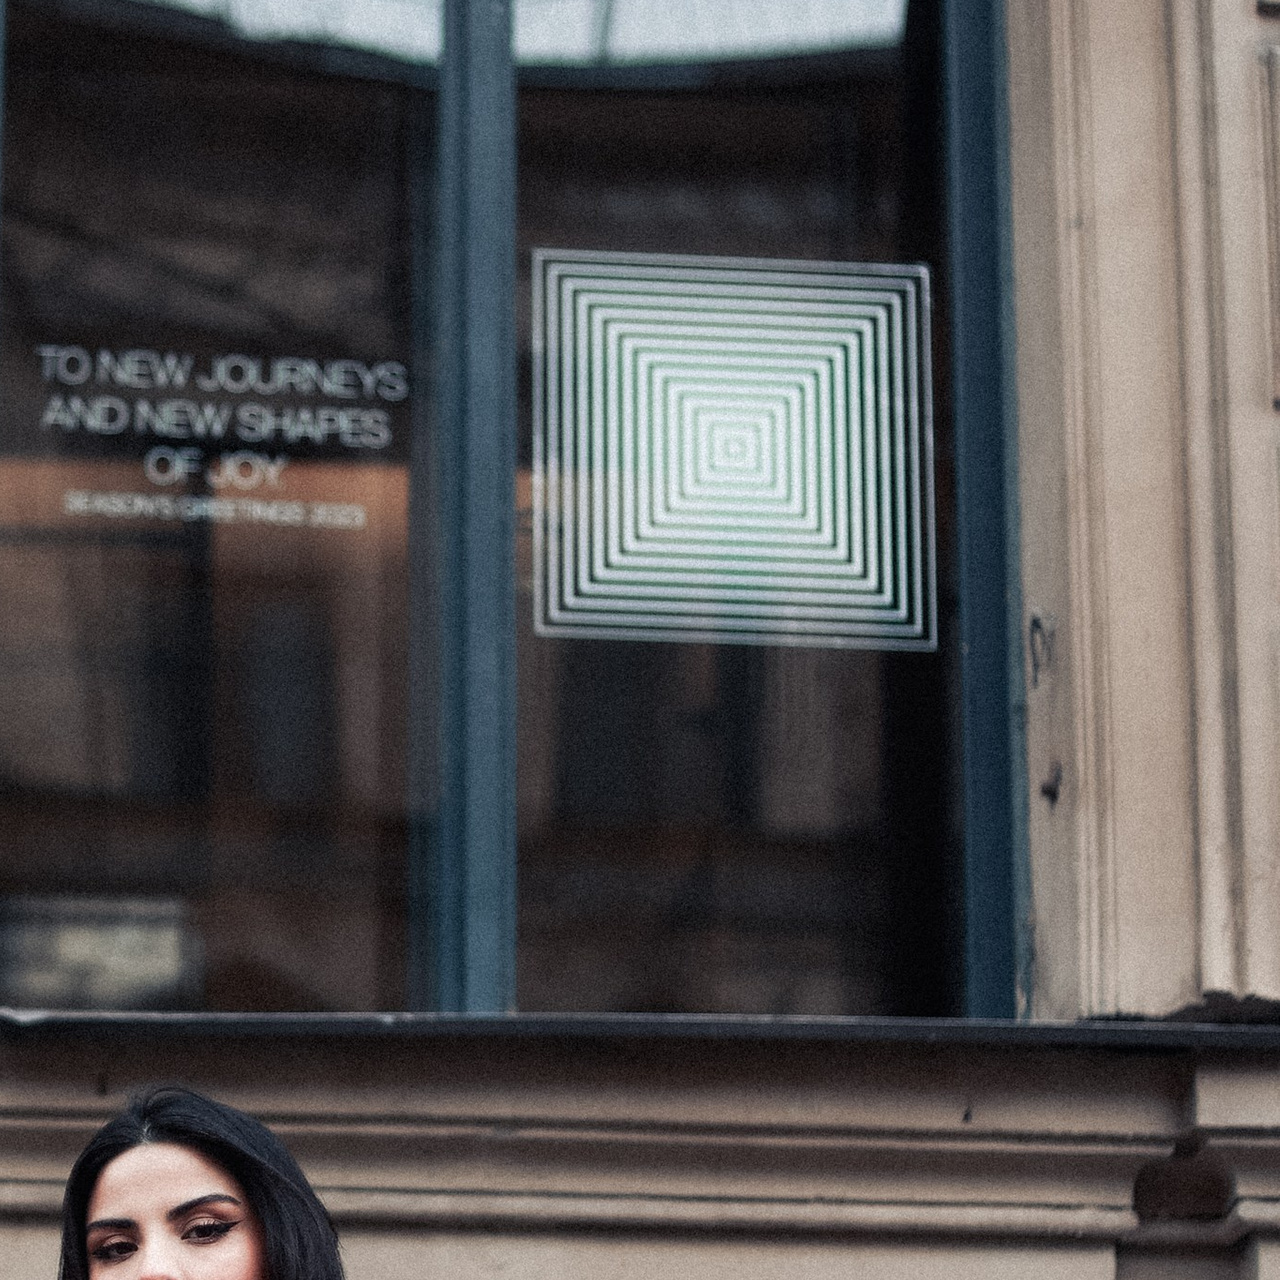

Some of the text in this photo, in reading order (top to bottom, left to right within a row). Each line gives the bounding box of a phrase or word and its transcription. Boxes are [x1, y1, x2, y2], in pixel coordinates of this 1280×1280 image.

[36, 345, 409, 402] TO NEW JOURNEYS
[41, 395, 393, 449] AND NEW SHAPES
[143, 445, 287, 490] OF JOY
